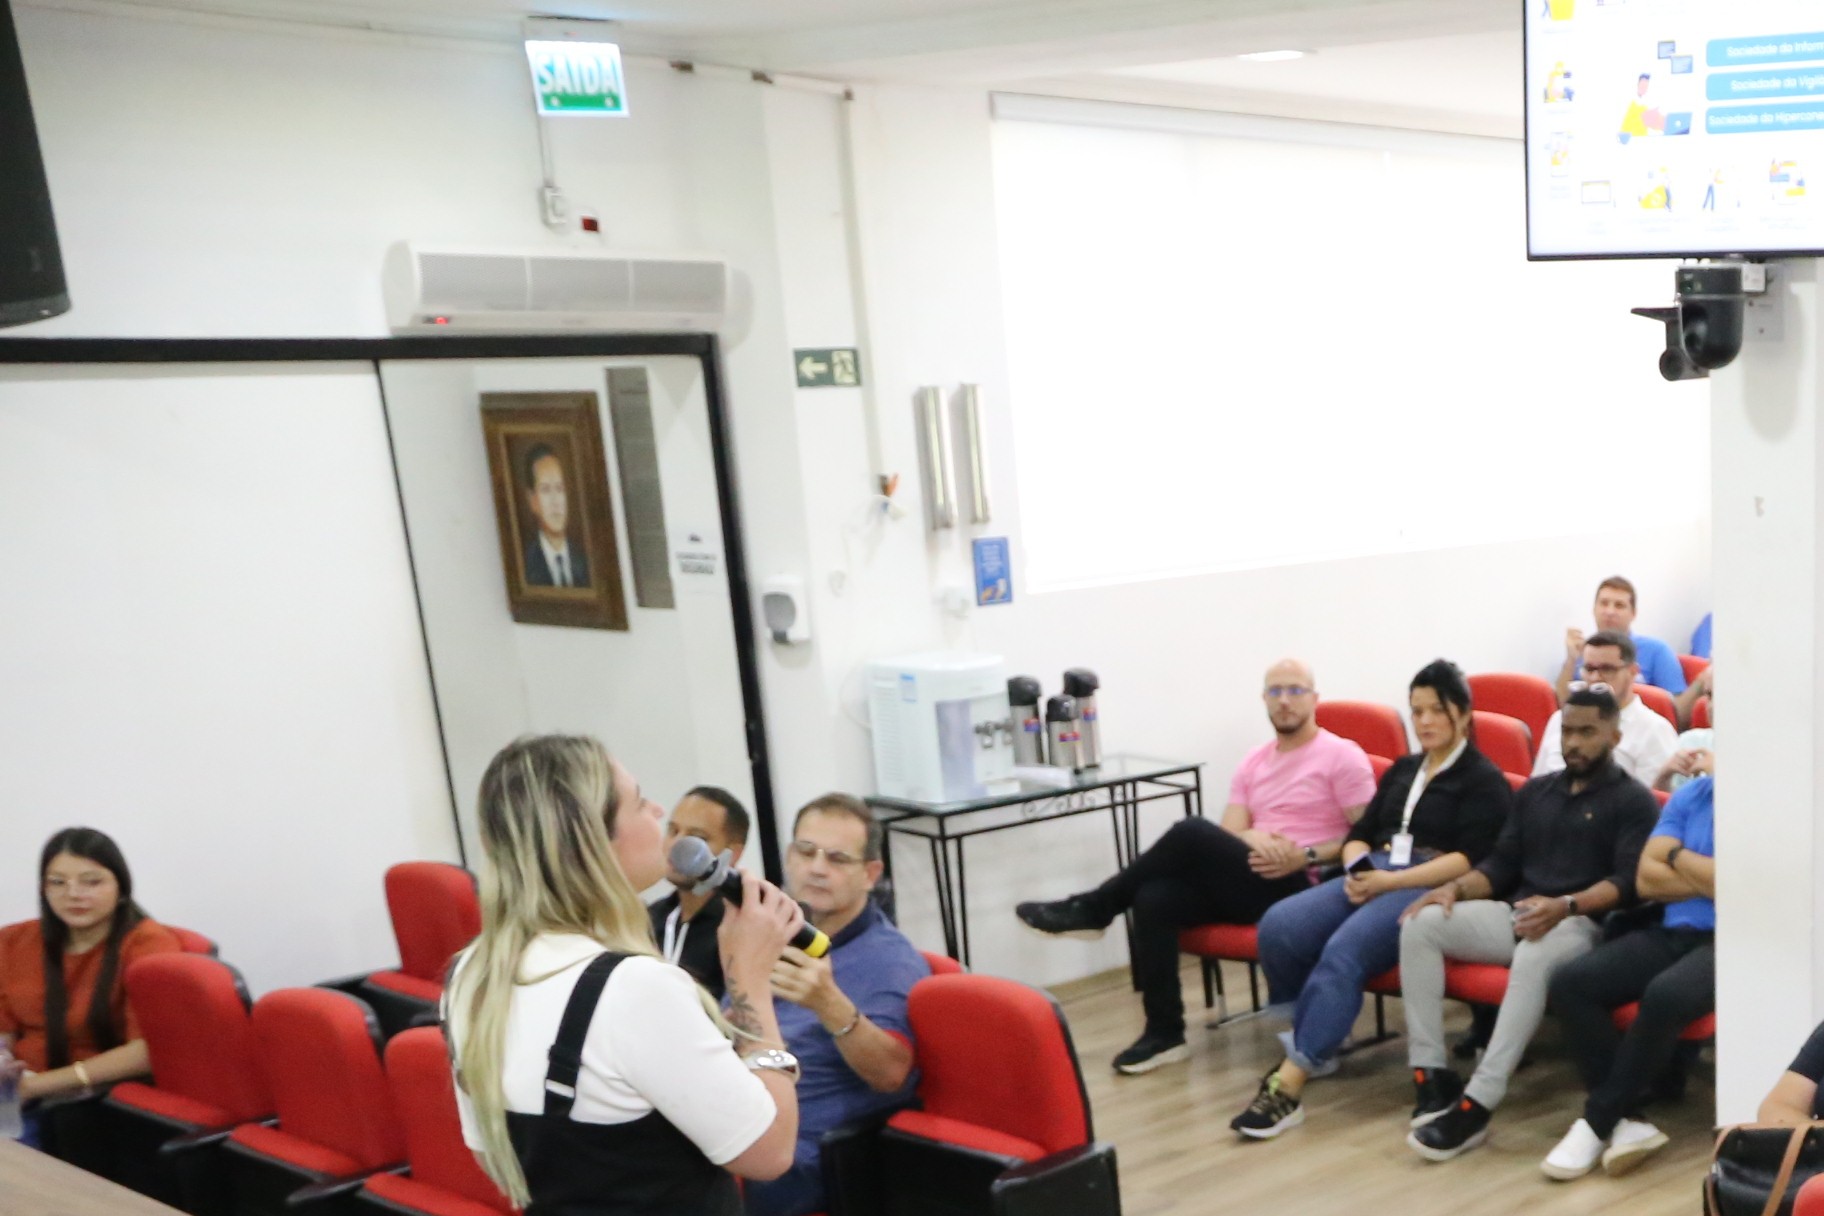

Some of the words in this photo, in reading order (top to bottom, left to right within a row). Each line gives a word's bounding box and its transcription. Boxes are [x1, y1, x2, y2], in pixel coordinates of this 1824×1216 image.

[1727, 44, 1778, 57] Sociedade
[1731, 78, 1781, 91] Sociedade
[1708, 113, 1758, 125] Sociedade
